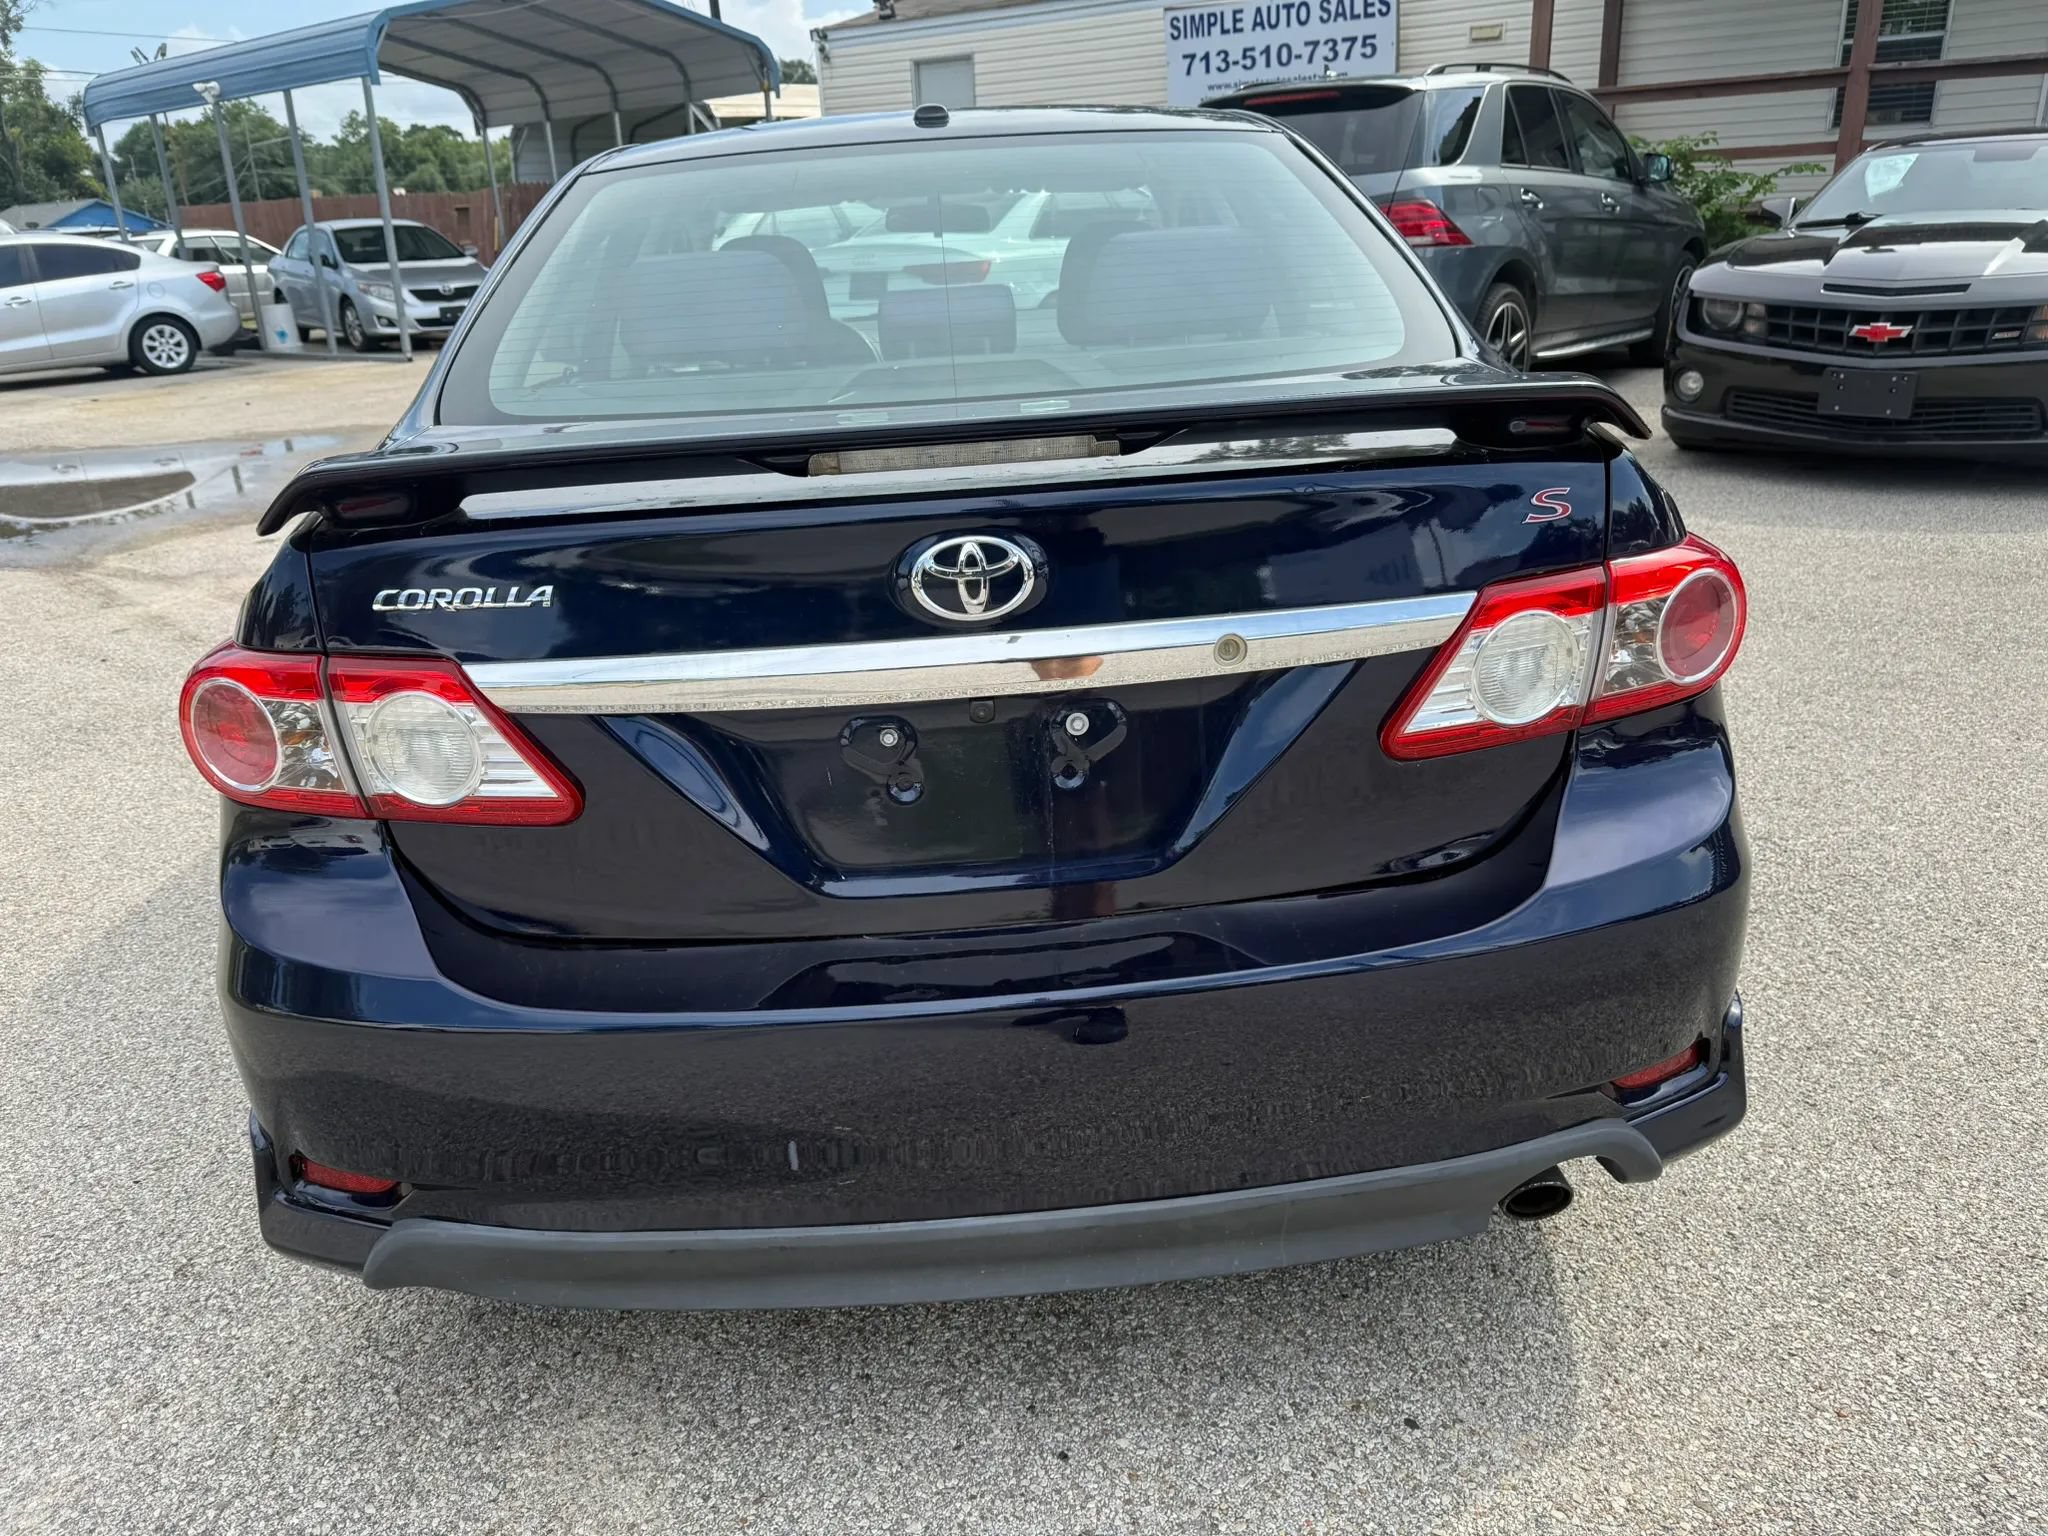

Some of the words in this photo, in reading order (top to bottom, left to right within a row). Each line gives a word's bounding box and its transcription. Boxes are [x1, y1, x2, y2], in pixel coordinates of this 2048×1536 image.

[1170, 9, 1244, 40] SIMPLE
[1252, 2, 1311, 32] AUTO
[1319, 0, 1391, 24] SALES
[1182, 34, 1378, 76] 713-510-7375
[1522, 487, 1572, 523] S
[372, 585, 554, 611] COROLLA
